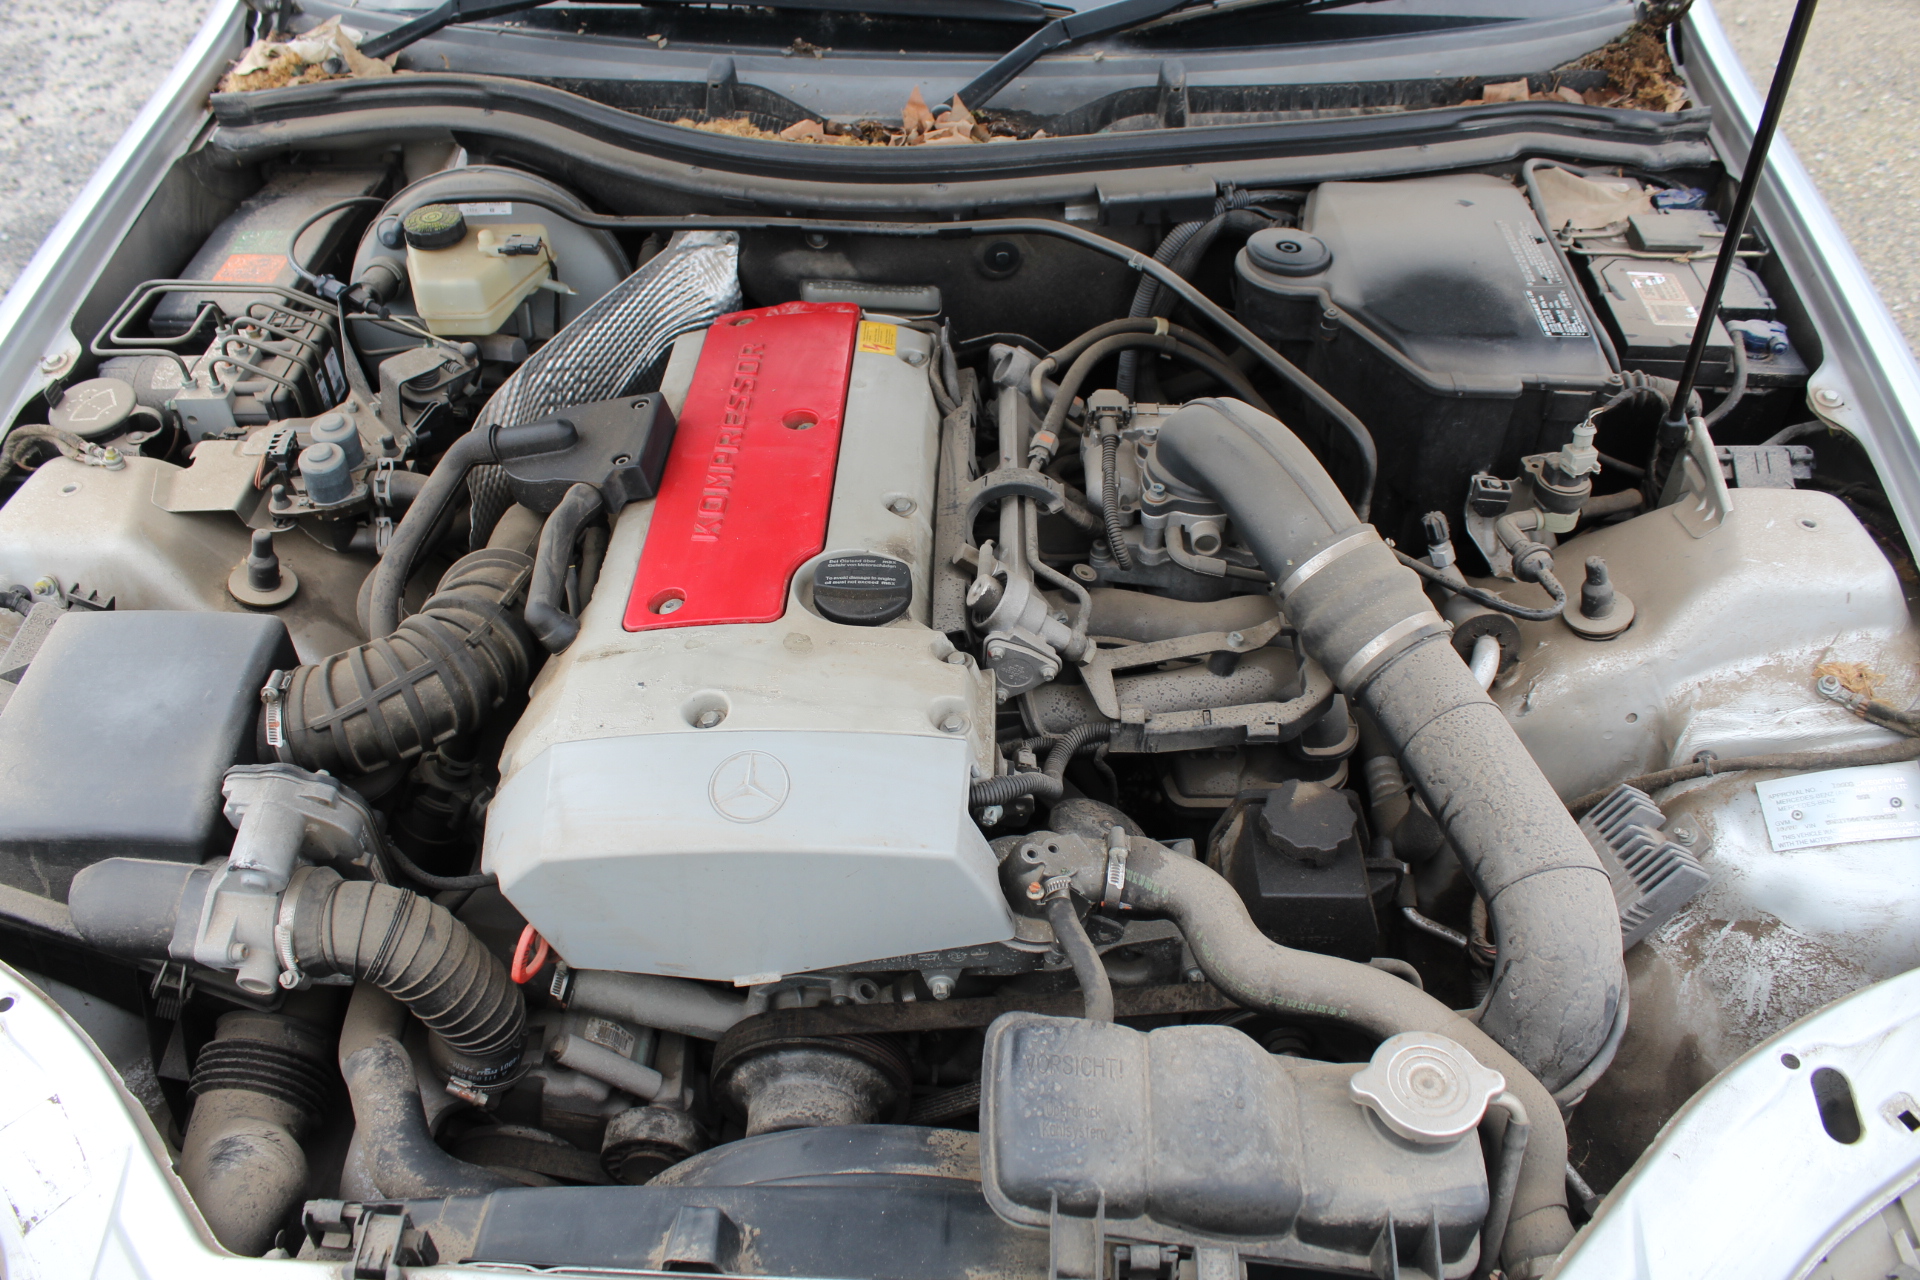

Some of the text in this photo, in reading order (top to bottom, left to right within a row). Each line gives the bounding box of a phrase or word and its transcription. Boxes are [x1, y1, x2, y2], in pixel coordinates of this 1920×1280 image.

[691, 342, 766, 542] KOMPRESSOR
[1768, 789, 1804, 800] APPROVAL
[1776, 791, 1834, 805] MERCEDES-BENZ
[1781, 833, 1796, 841] THIS
[1796, 829, 1823, 838] VEHICLE
[1778, 841, 1795, 849] WITH
[1795, 838, 1809, 846] THE
[1025, 1053, 1123, 1079] VORSICHT!
